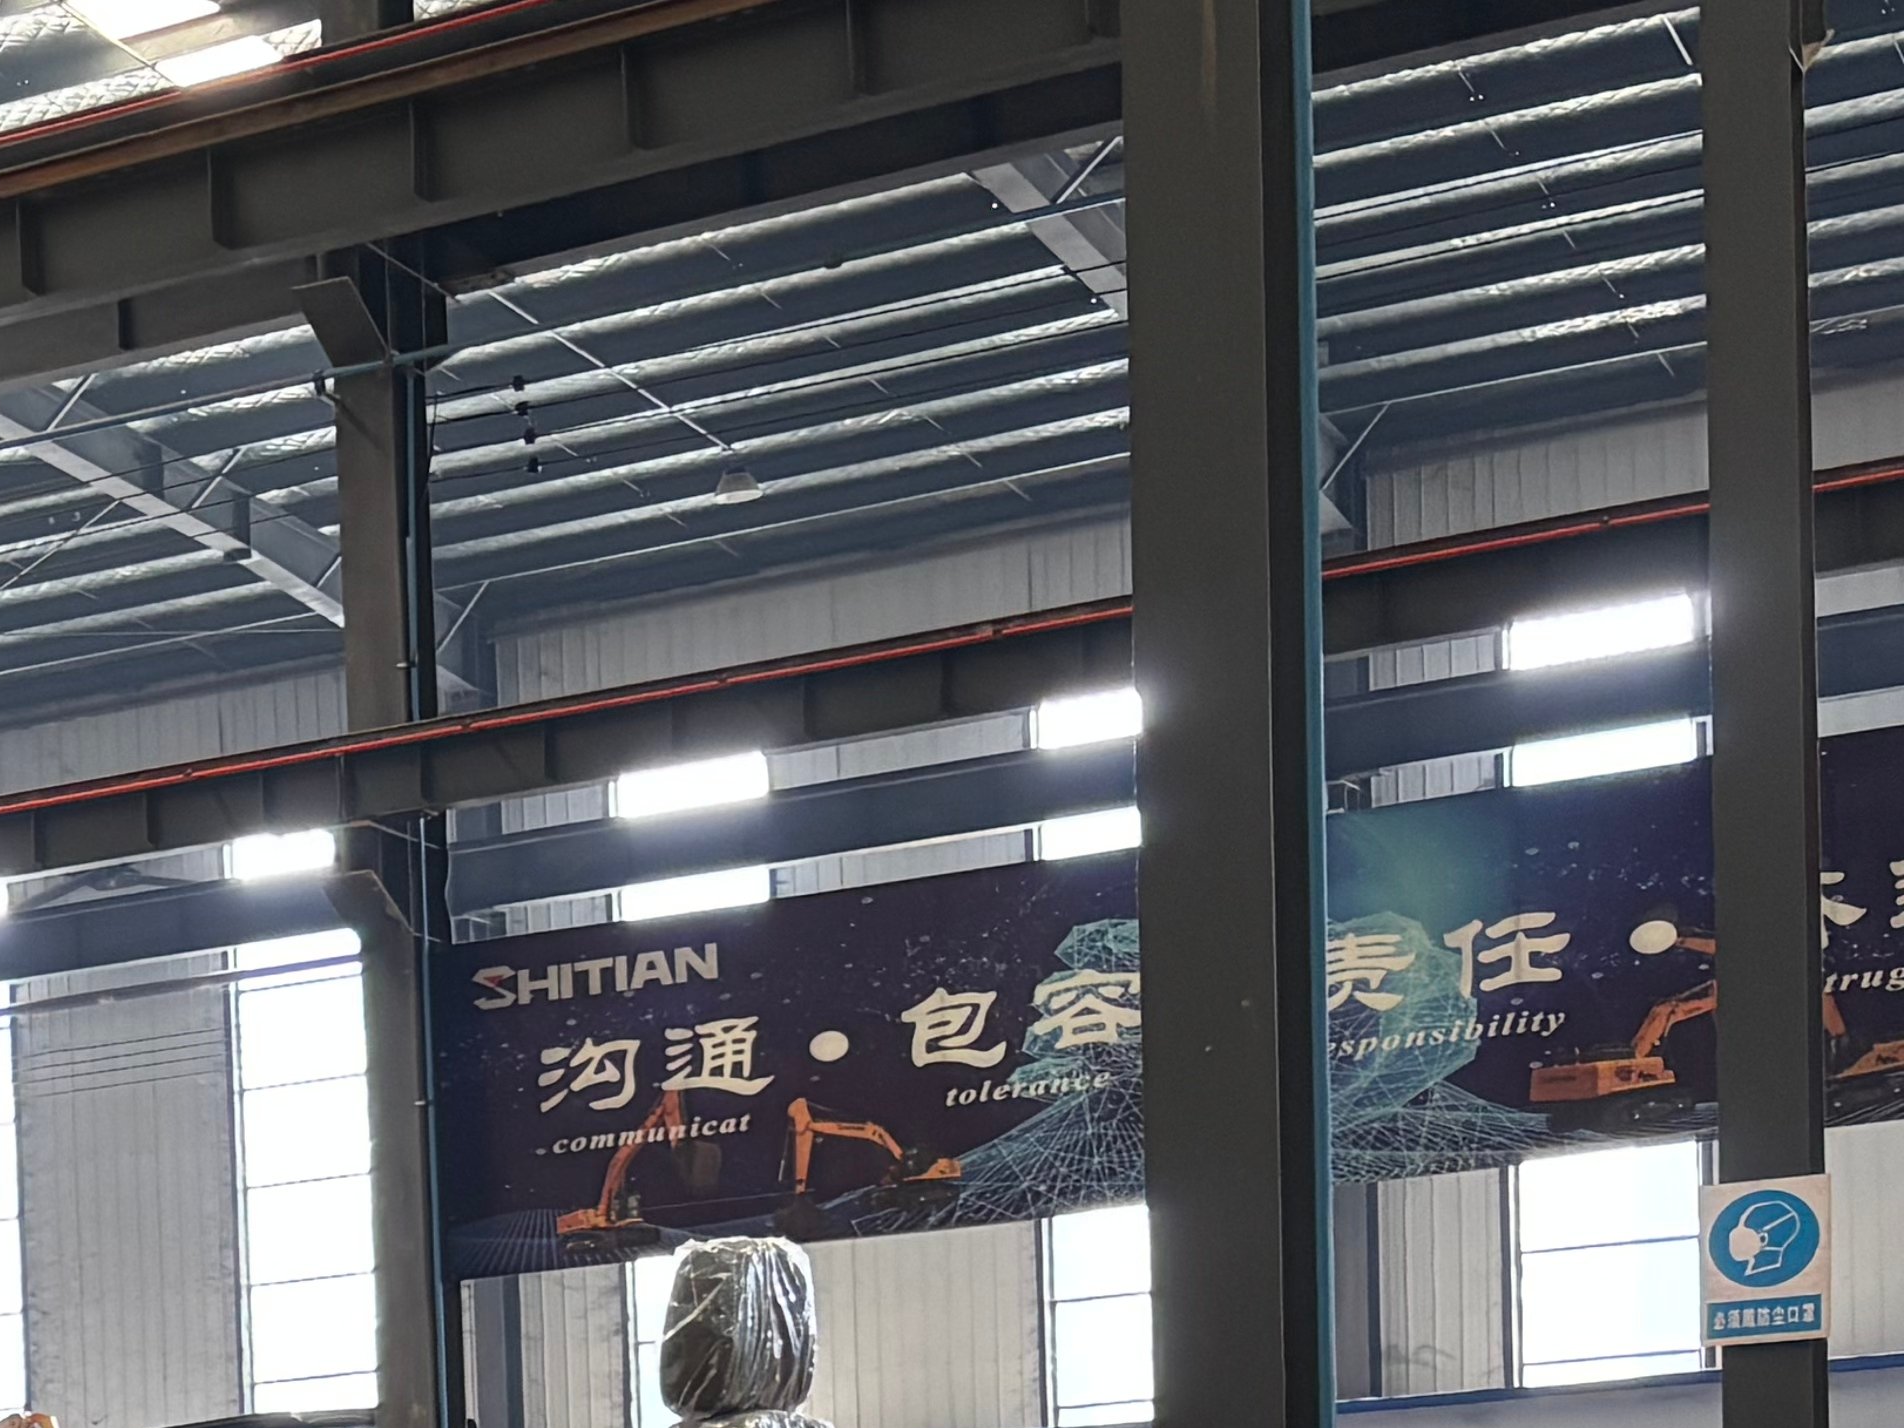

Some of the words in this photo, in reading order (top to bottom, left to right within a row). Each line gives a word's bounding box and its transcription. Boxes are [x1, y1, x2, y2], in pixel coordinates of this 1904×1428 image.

[471, 942, 719, 1010] SHITIAN
[537, 1015, 776, 1113] 沟通
[900, 968, 1142, 1068] 包容
[1326, 911, 1572, 1012] 责任
[552, 1112, 752, 1155] communicat
[944, 1070, 1112, 1107] tolerance
[1328, 1007, 1567, 1062] sponsibility
